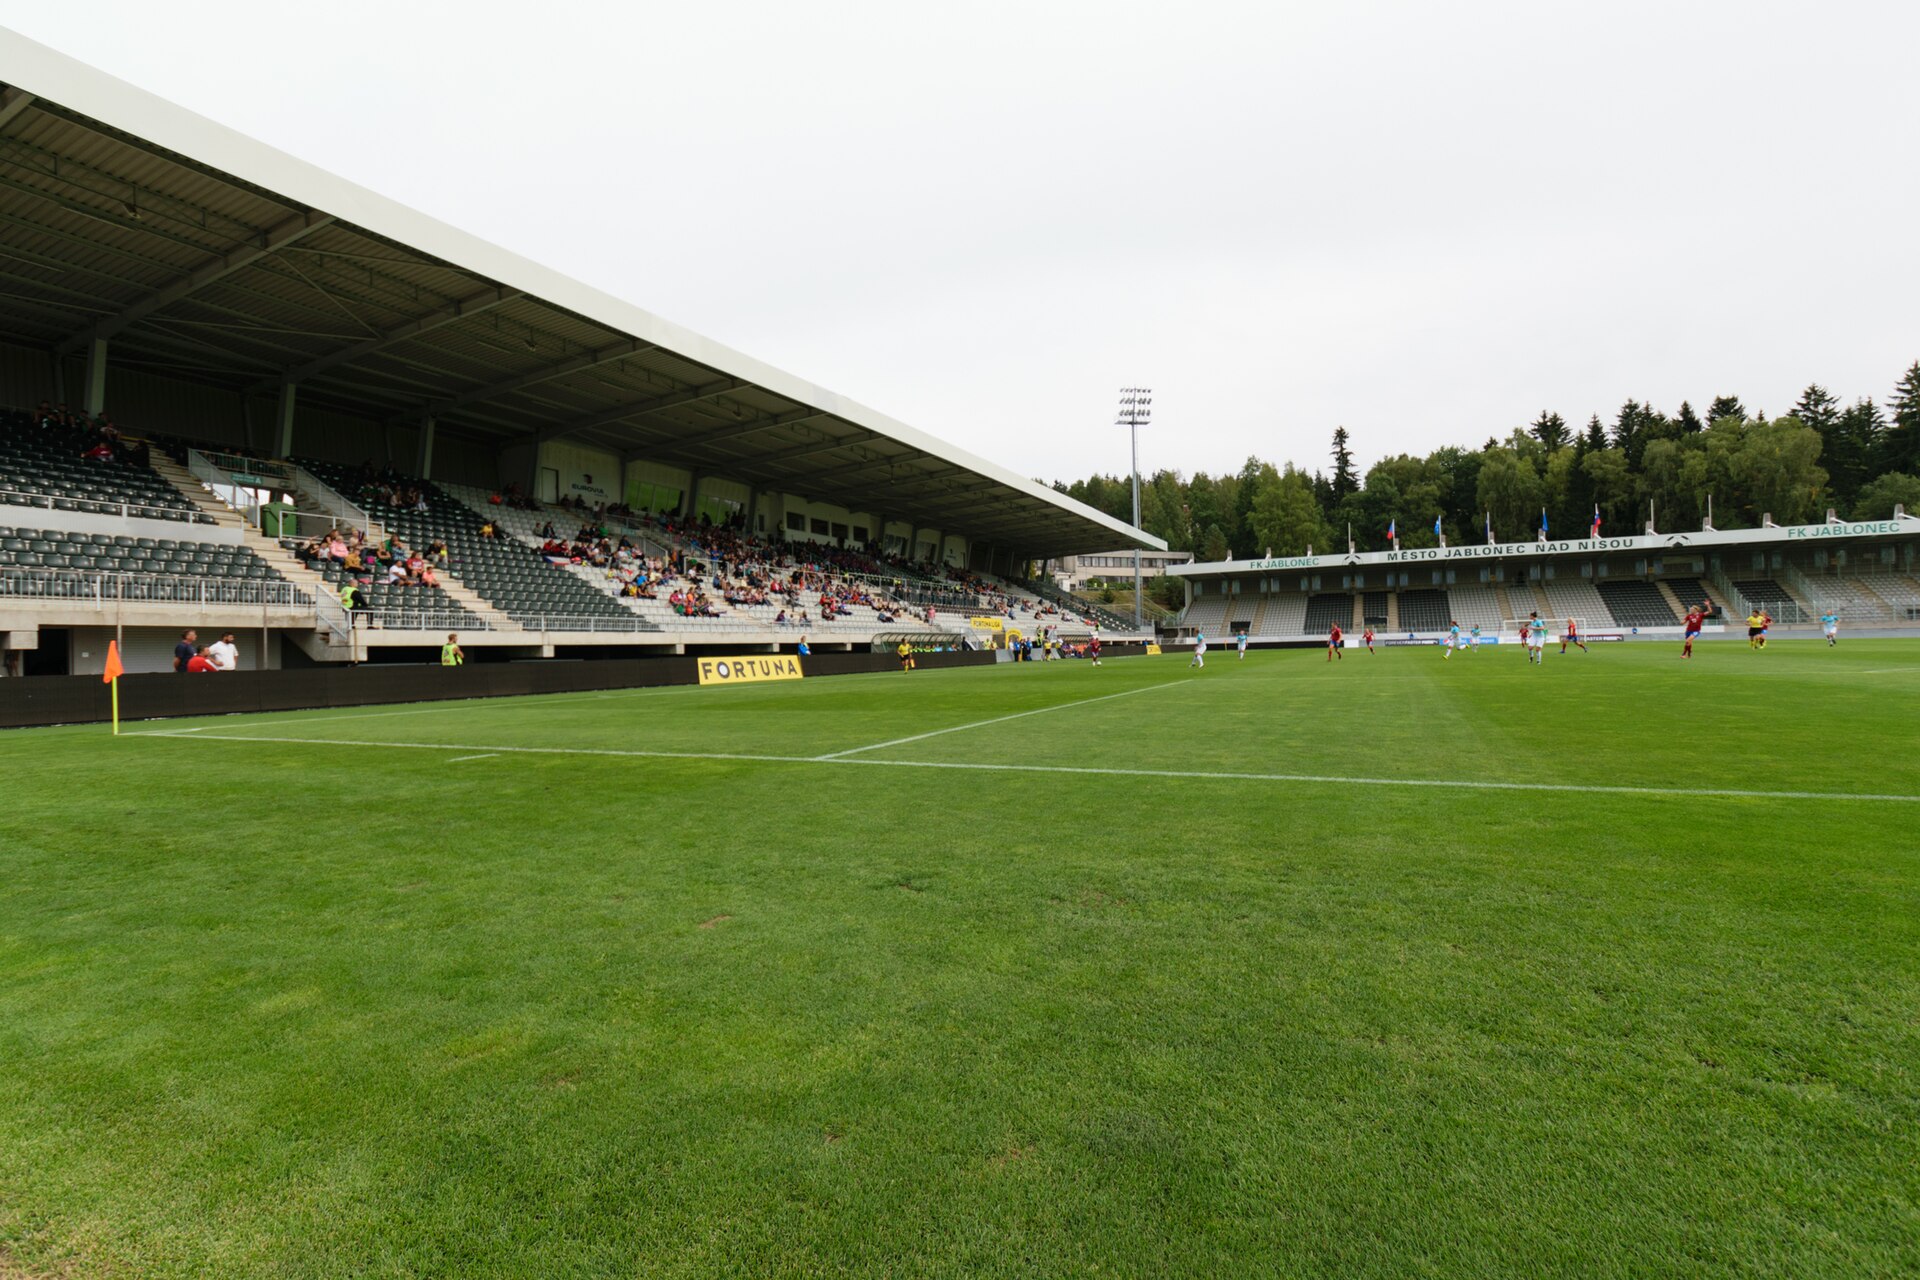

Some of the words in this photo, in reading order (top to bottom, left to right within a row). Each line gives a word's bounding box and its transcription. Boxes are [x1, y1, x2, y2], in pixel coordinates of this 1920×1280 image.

[1788, 528, 1806, 537] FK
[1811, 522, 1900, 536] JABLONEC
[1444, 545, 1526, 557] JABLONEC
[1535, 543, 1570, 552] NAD
[1578, 539, 1633, 550] NISOU
[1250, 561, 1263, 569] FK
[1265, 558, 1320, 568] JABLONEC
[701, 660, 798, 680] FORTUNA
